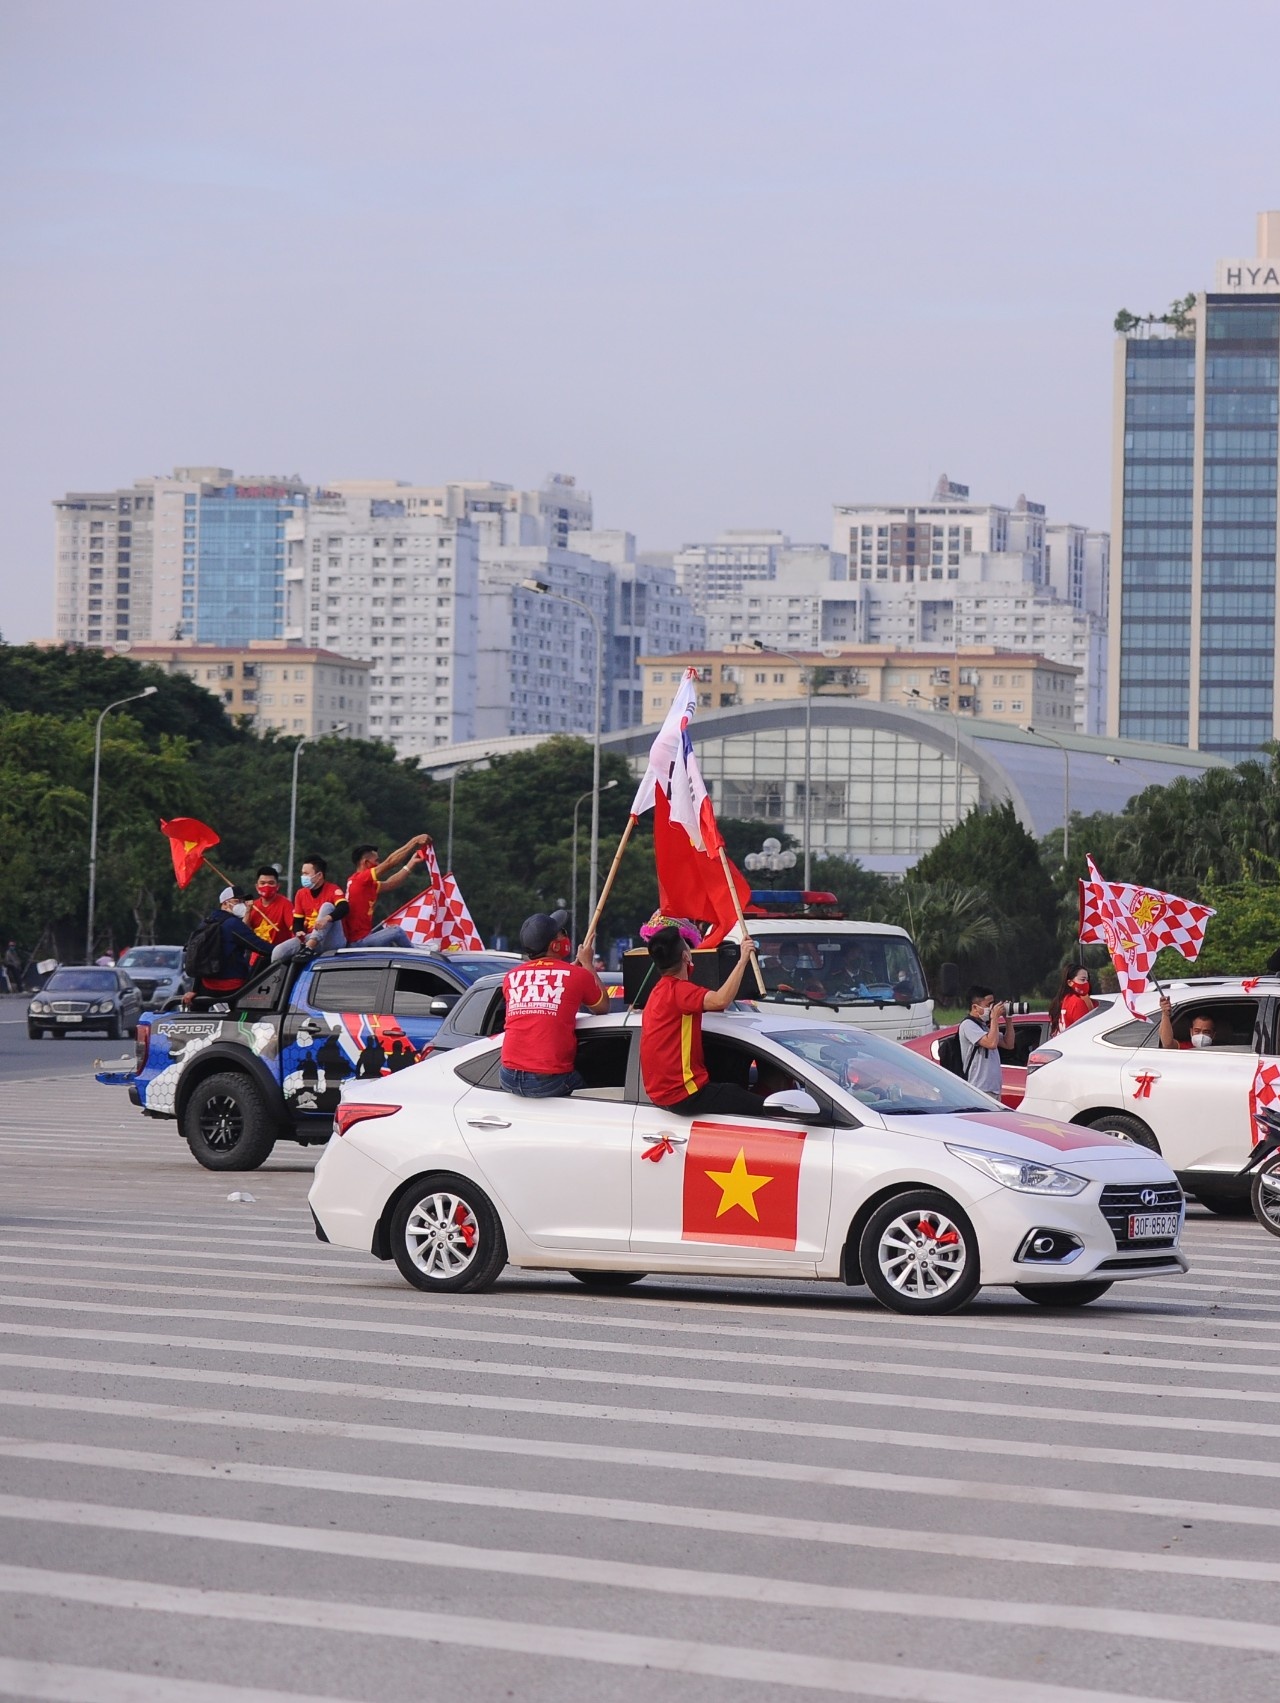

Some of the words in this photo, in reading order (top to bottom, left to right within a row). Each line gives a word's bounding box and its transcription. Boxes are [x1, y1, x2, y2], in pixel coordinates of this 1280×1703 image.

[508, 969, 571, 989] VIET
[508, 984, 565, 1005] NAM
[158, 1024, 214, 1034] RAPTOR
[1135, 1216, 1177, 1236] 30F-858.29
